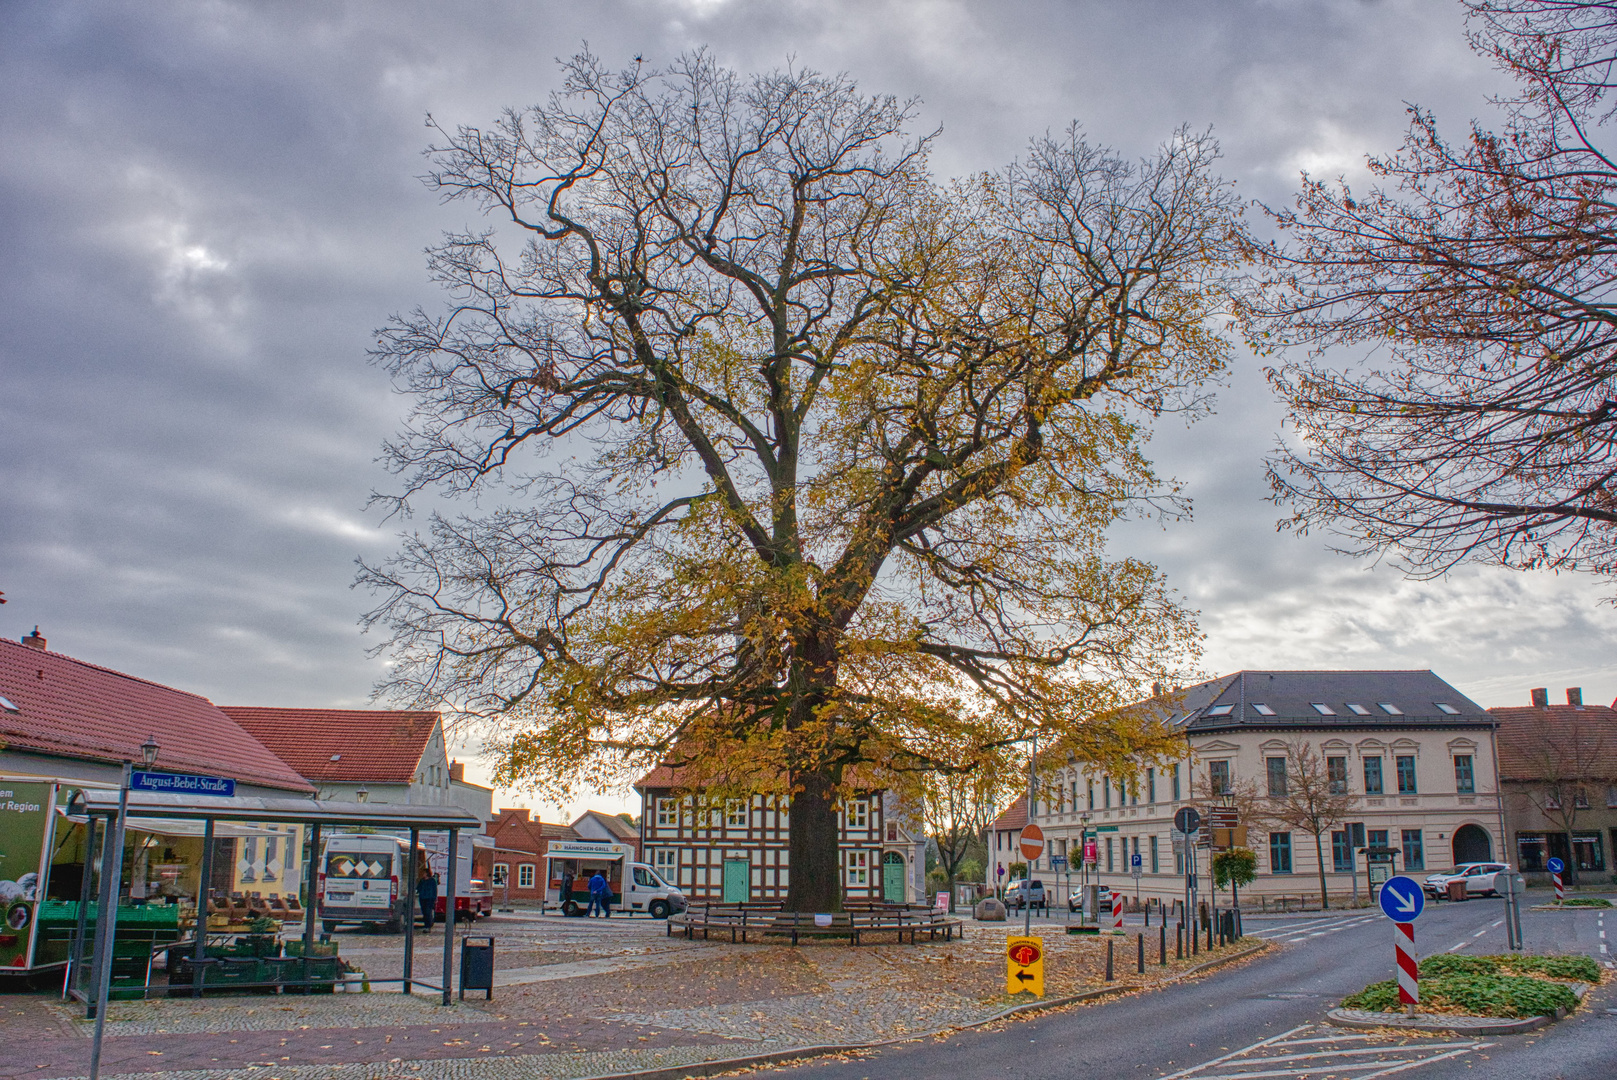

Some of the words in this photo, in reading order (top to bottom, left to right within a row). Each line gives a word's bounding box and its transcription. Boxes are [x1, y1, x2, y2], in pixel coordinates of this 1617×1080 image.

[140, 774, 228, 791] August-Bebel-Straße
[7, 800, 40, 813] Region
[1133, 855, 1140, 865] P
